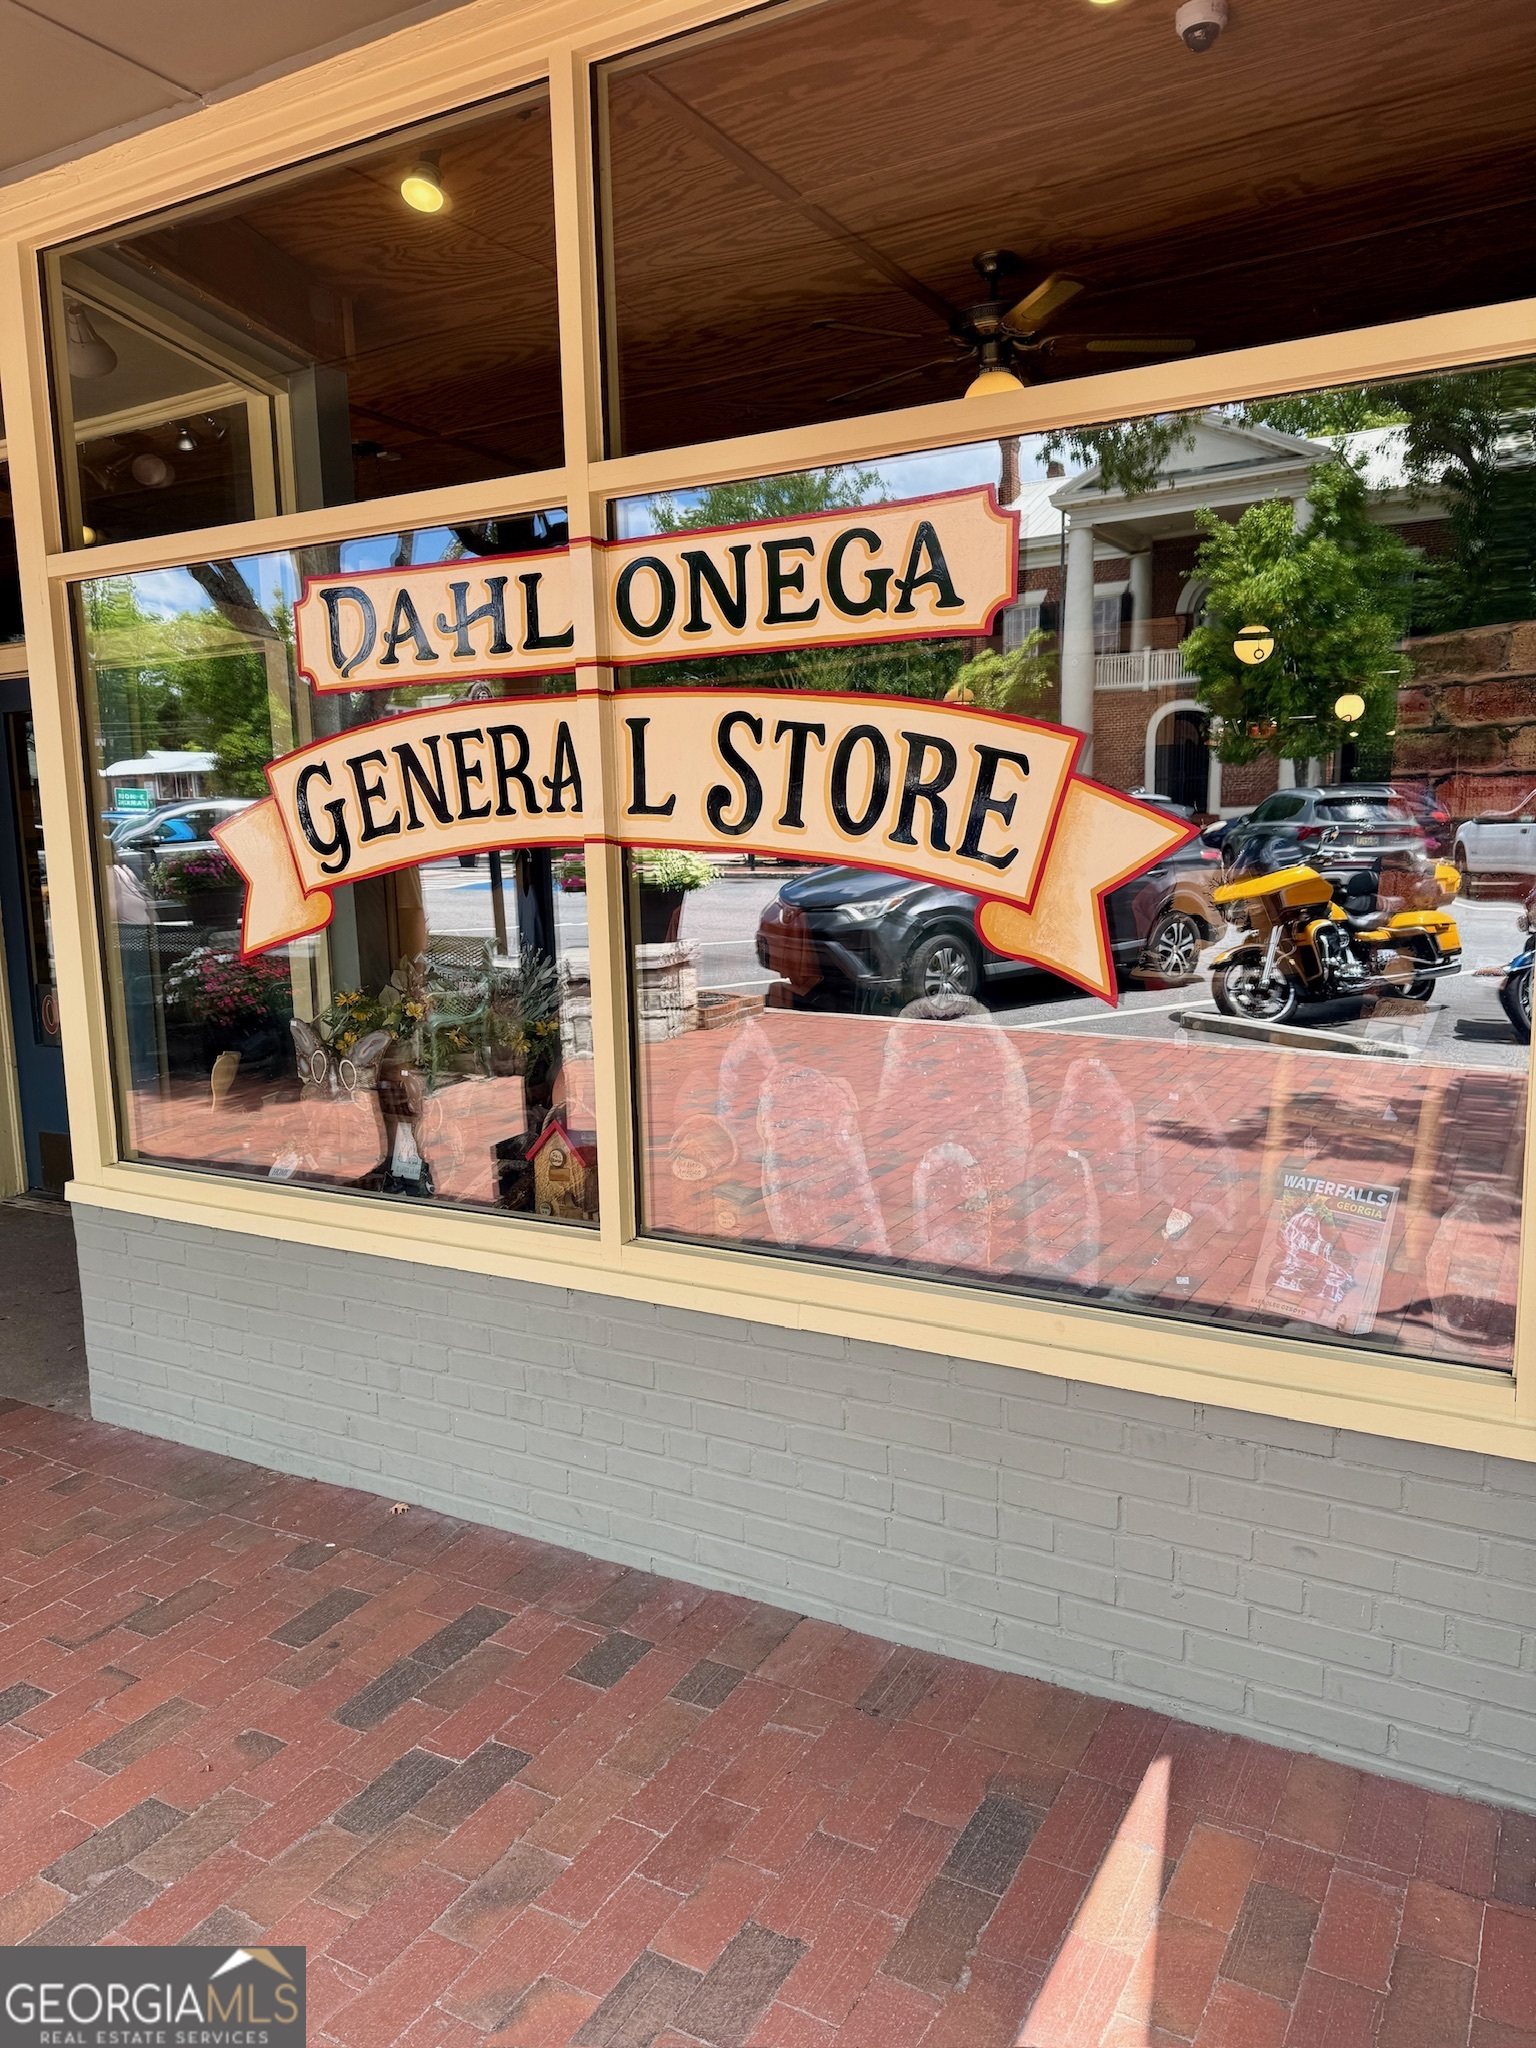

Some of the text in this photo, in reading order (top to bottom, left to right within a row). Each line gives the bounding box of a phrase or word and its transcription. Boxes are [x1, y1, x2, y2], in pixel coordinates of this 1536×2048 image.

[707, 711, 1030, 870] STORE
[1284, 1175, 1388, 1207] WATERFALLS
[1336, 1201, 1383, 1219] GEORGIA
